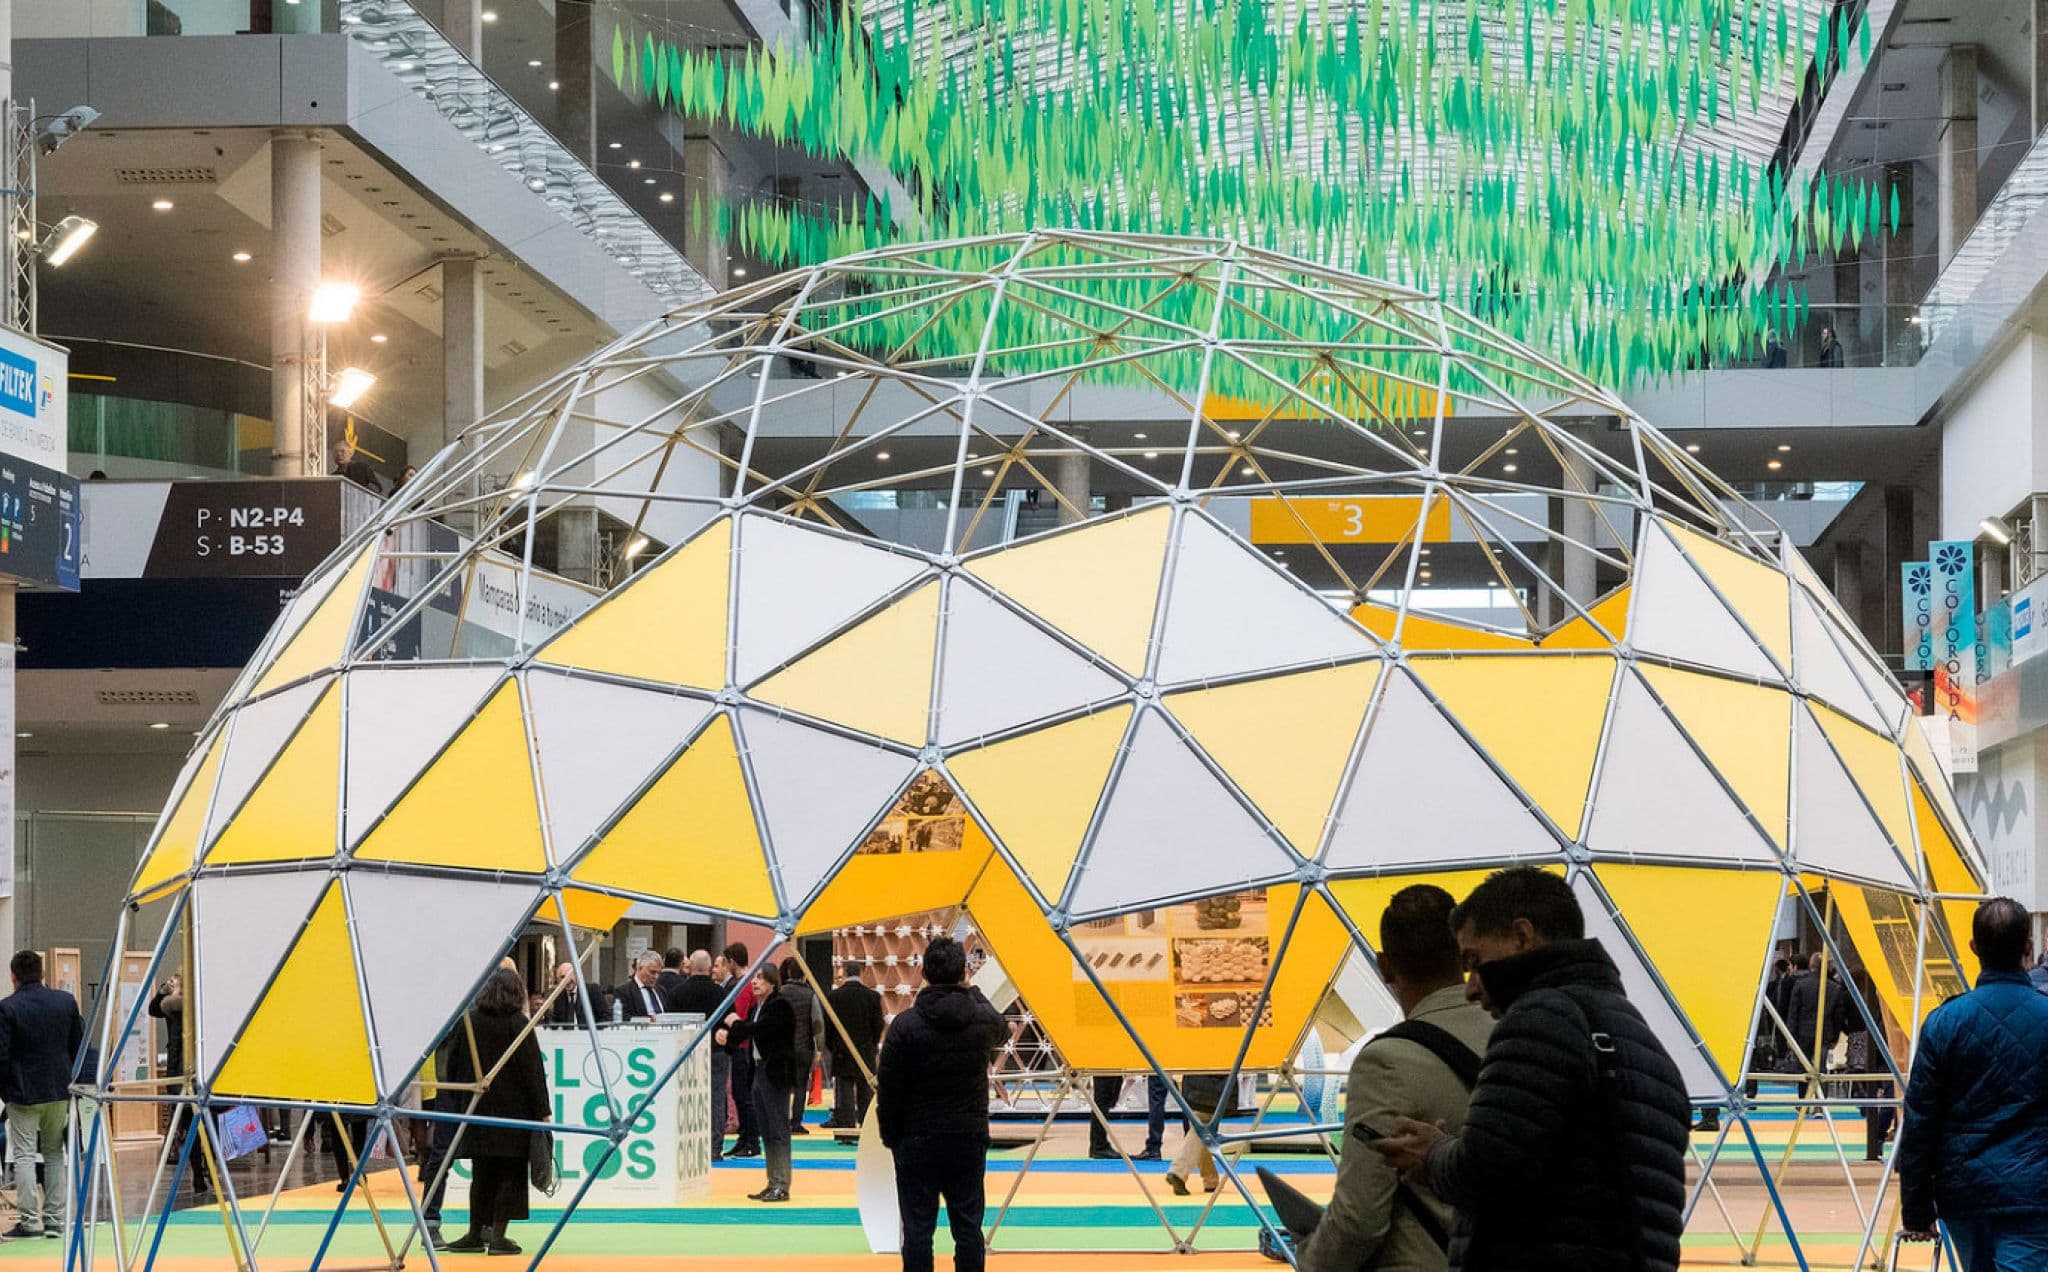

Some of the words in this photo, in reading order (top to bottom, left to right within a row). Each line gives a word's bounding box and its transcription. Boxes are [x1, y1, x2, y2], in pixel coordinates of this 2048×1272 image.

[197, 508, 211, 528] P
[230, 507, 304, 528] N2-P4
[1343, 504, 1363, 536] 3
[63, 523, 72, 560] 2
[197, 535, 210, 556] S
[230, 535, 285, 555] B-53
[1945, 579, 1961, 722] COLORONDA
